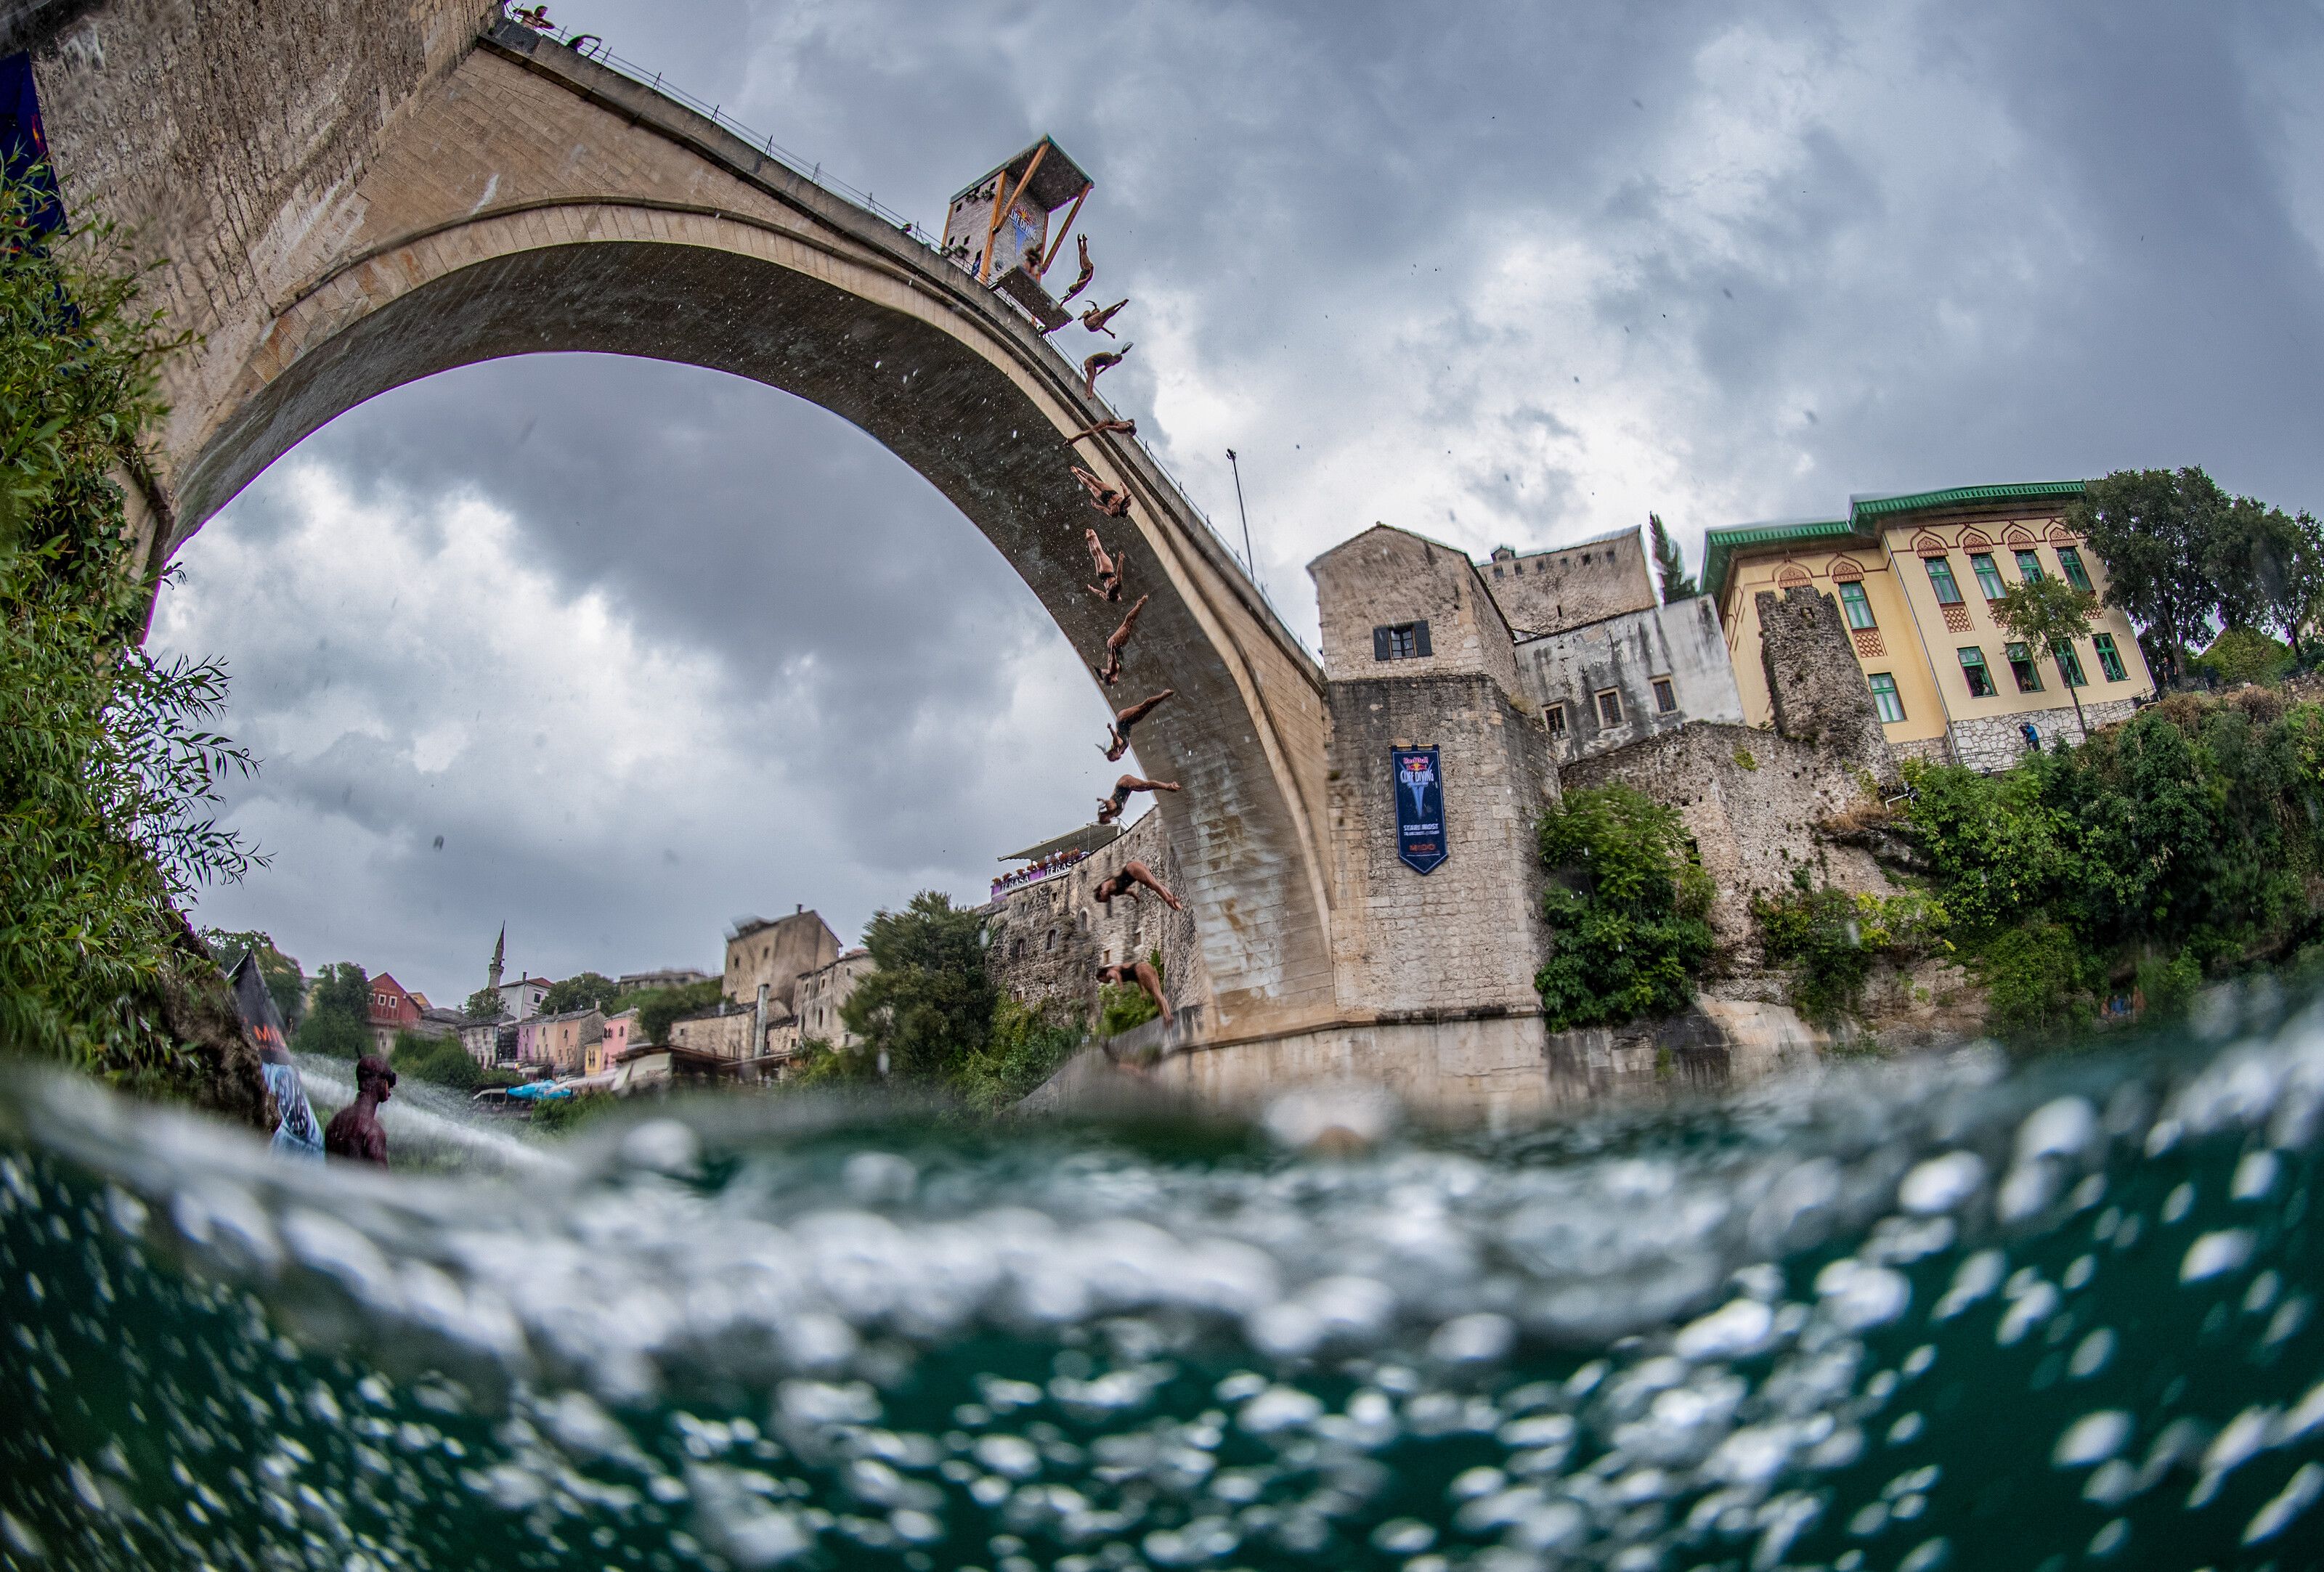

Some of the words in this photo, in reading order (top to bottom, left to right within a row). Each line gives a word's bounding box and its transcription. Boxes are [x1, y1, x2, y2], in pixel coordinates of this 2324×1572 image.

[1009, 208, 1020, 224] LIFF
[1020, 219, 1036, 240] DIVING
[1415, 769, 1434, 782] DIVING
[1000, 875, 1030, 891] TERASA
